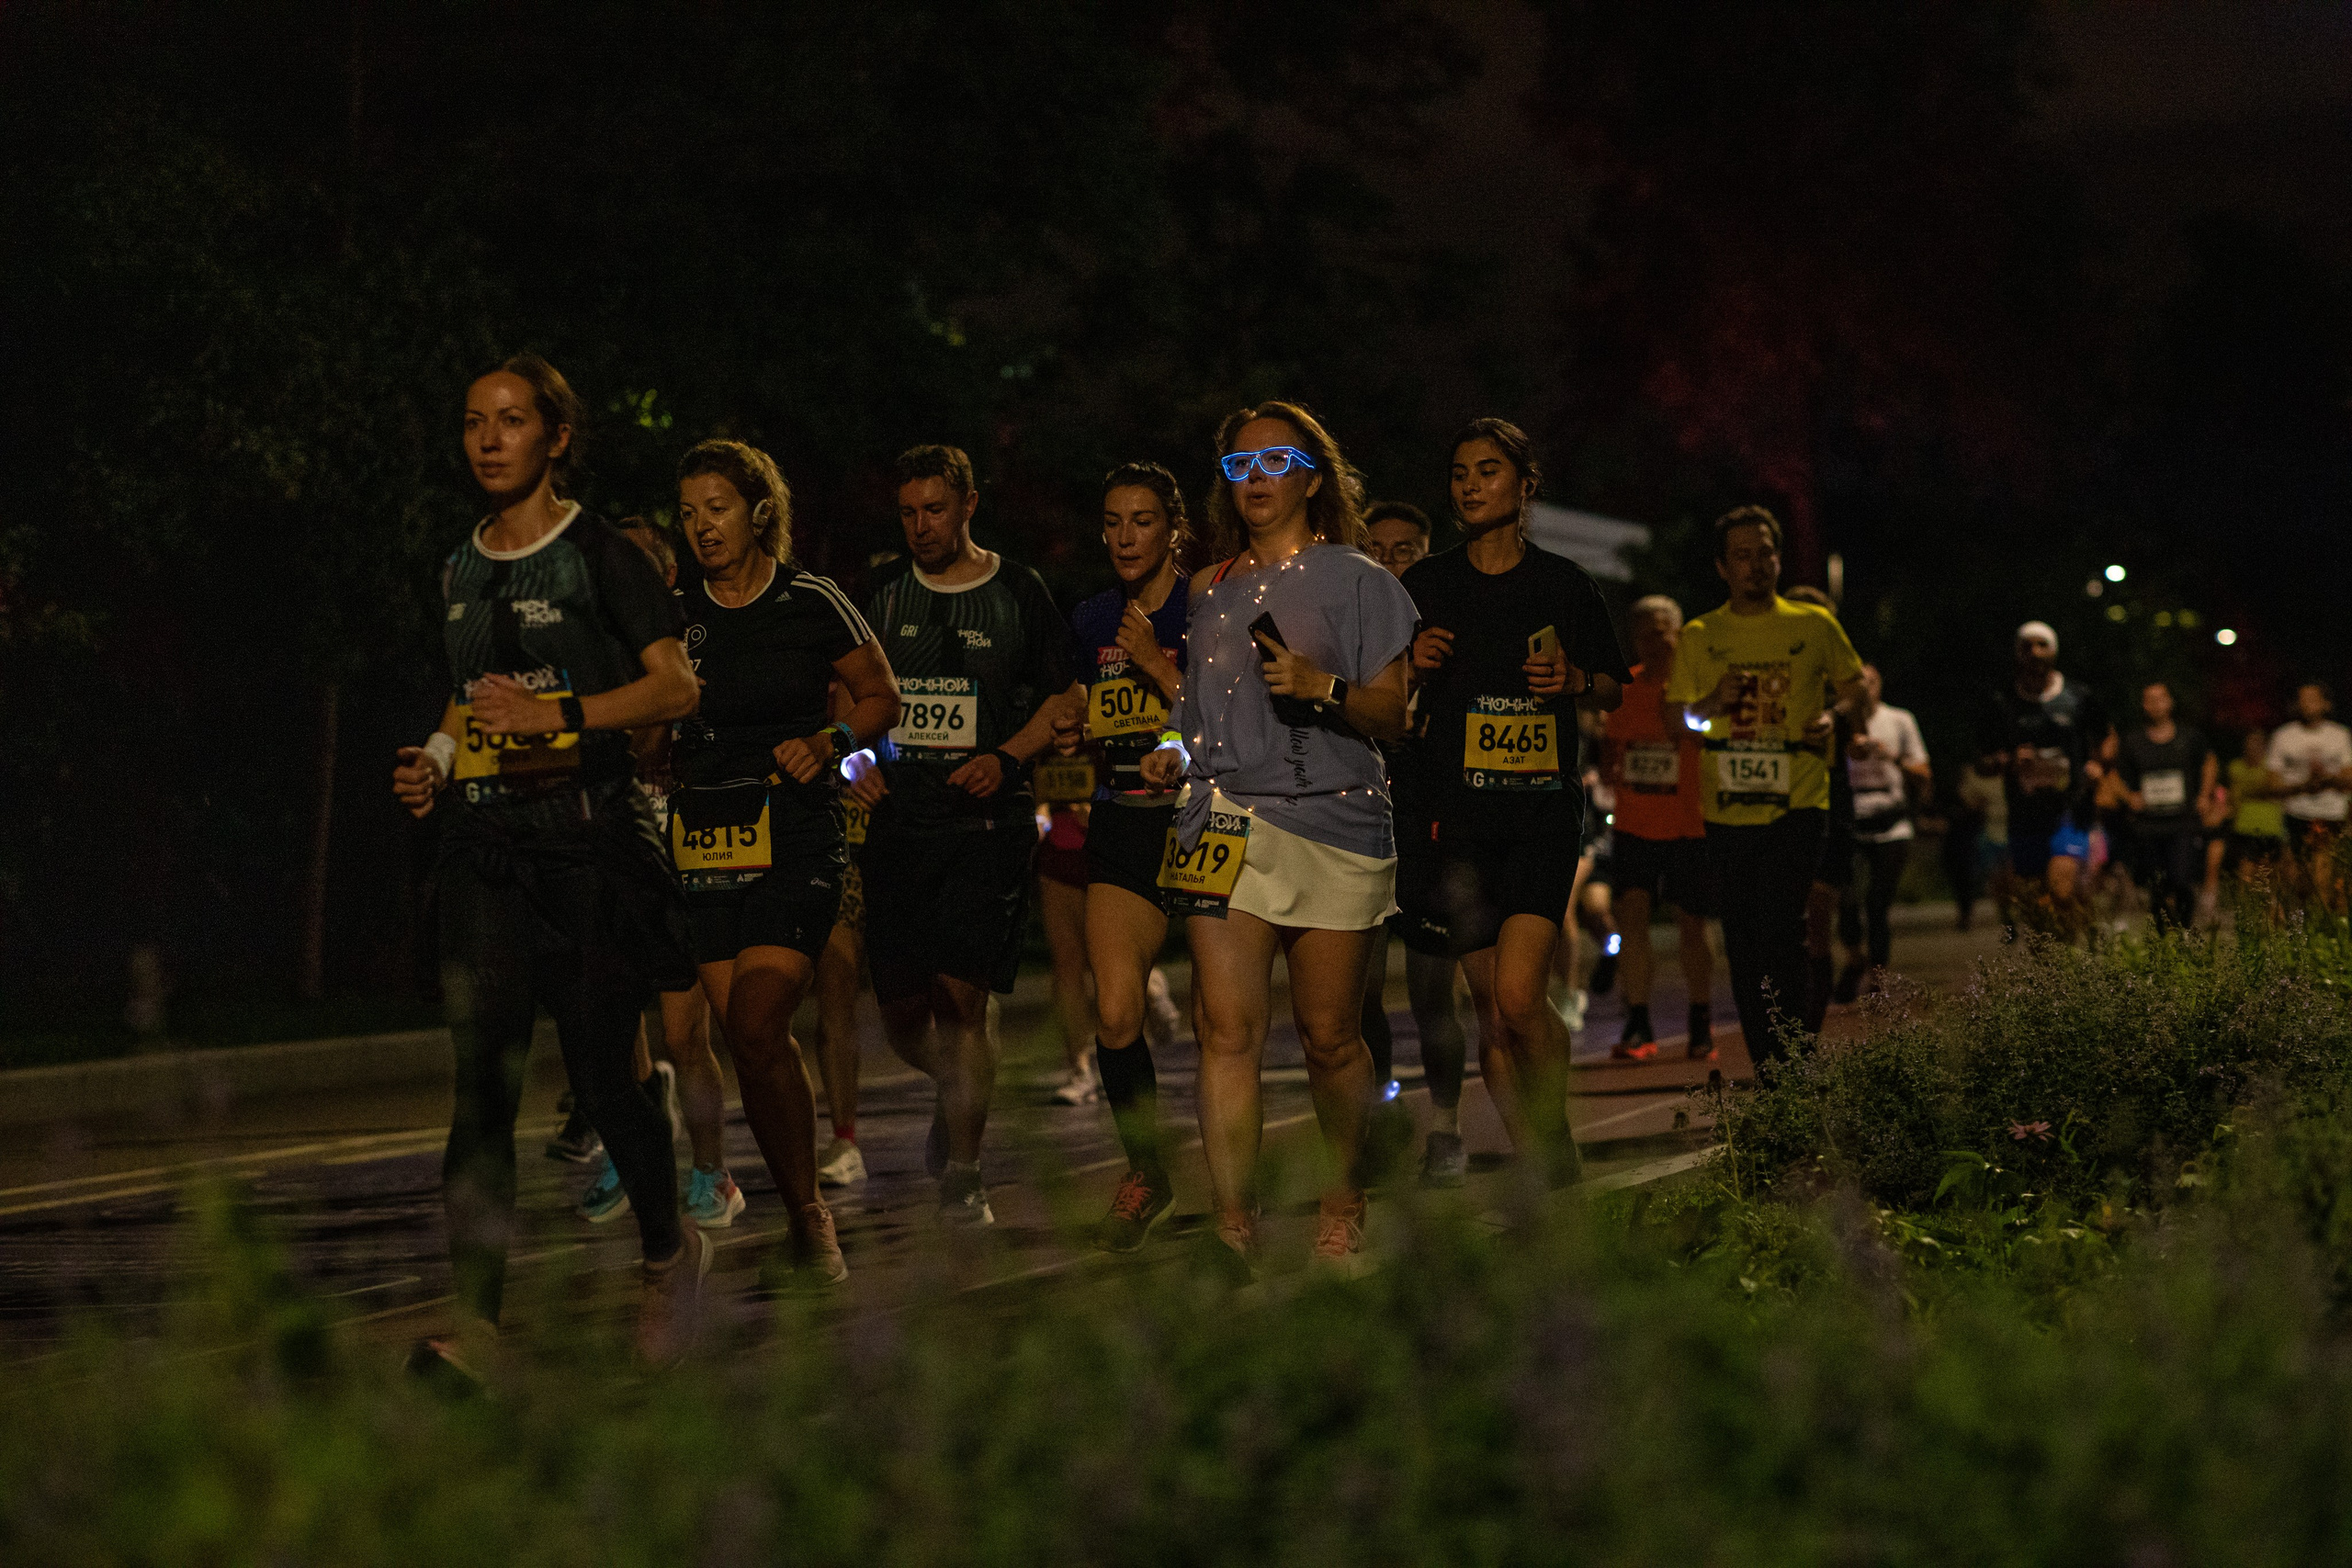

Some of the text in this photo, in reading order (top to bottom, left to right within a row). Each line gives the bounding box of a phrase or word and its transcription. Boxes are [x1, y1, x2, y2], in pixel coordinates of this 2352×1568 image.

[899, 703, 965, 730] 7896
[1114, 715, 1160, 728] СВЕТЛАНА
[908, 730, 949, 741] АЛЕКСЕЙ
[1478, 723, 1547, 753] 8465
[1473, 772, 1486, 788] G
[1730, 759, 1779, 780] 1541
[465, 782, 481, 804] G
[682, 827, 758, 851] 4815
[702, 852, 733, 862] ЮЛИЯ
